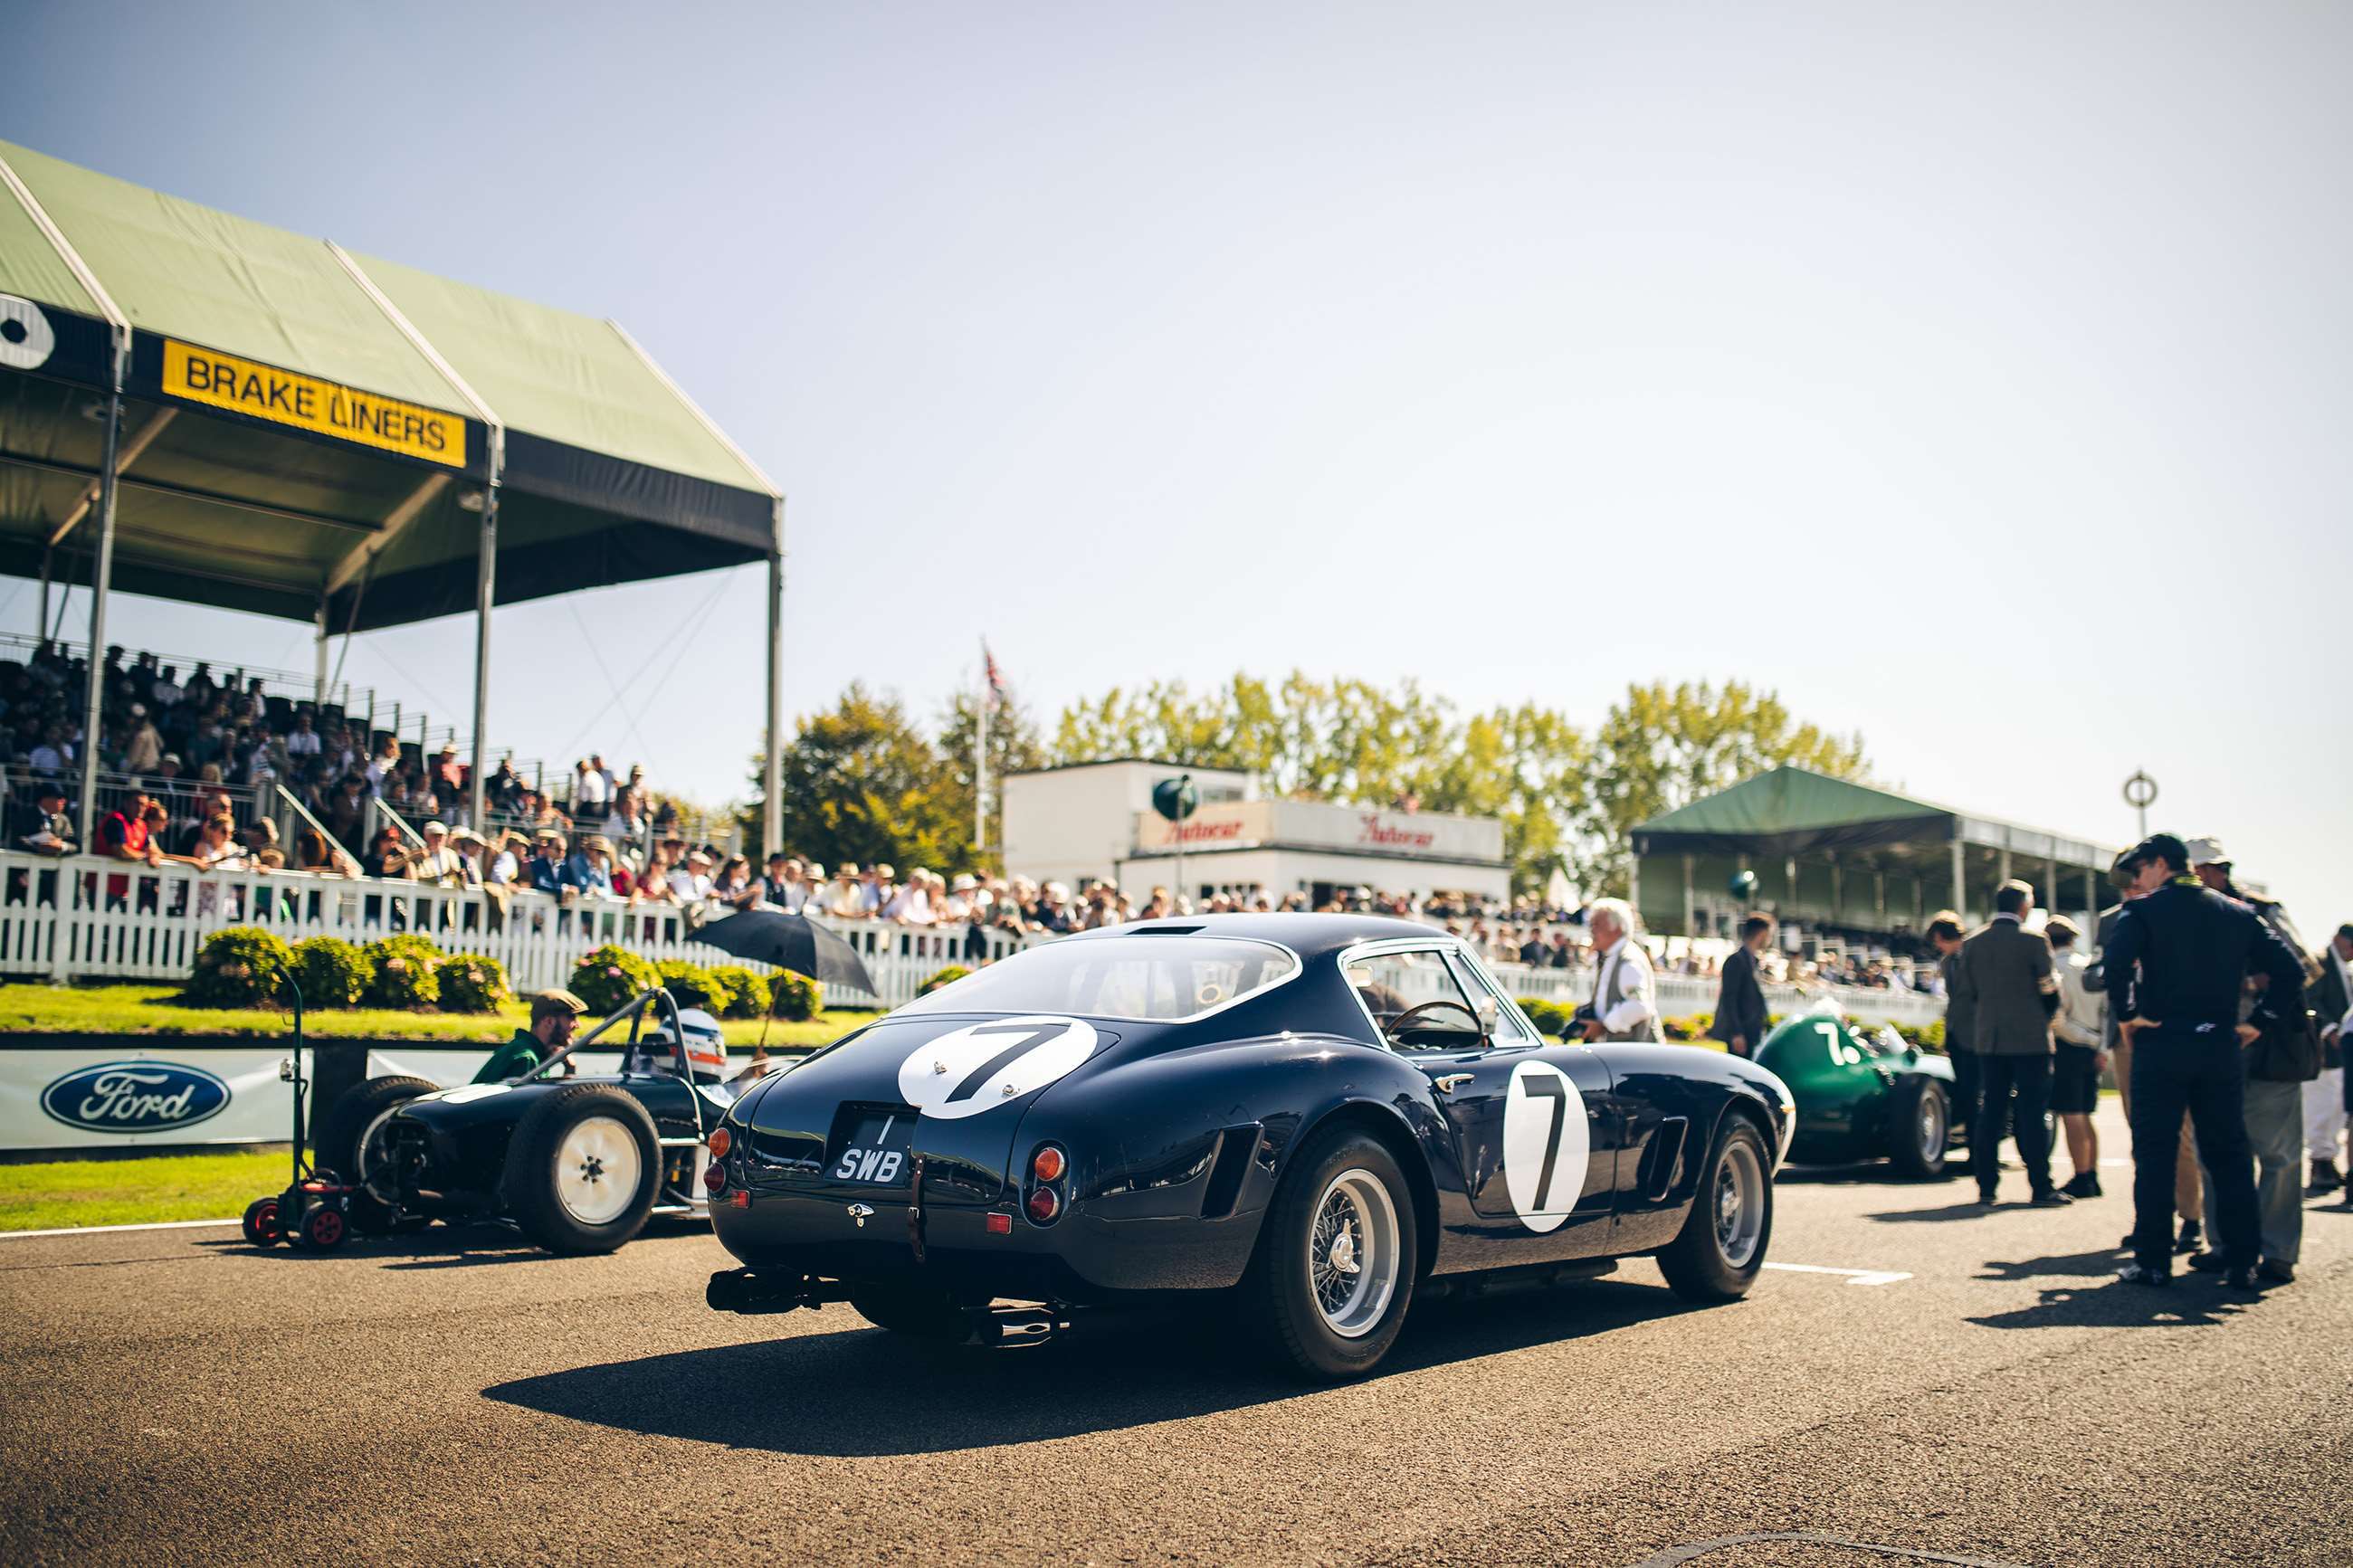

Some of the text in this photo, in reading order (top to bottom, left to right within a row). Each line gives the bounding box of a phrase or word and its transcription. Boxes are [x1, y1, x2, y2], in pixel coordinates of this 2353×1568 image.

[186, 356, 445, 451] BRAKE LINERS
[79, 1071, 195, 1120] Ford
[944, 1022, 1074, 1104] 7
[877, 1115, 895, 1145] 1
[1520, 1074, 1567, 1212] 7
[836, 1148, 903, 1183] SWB
